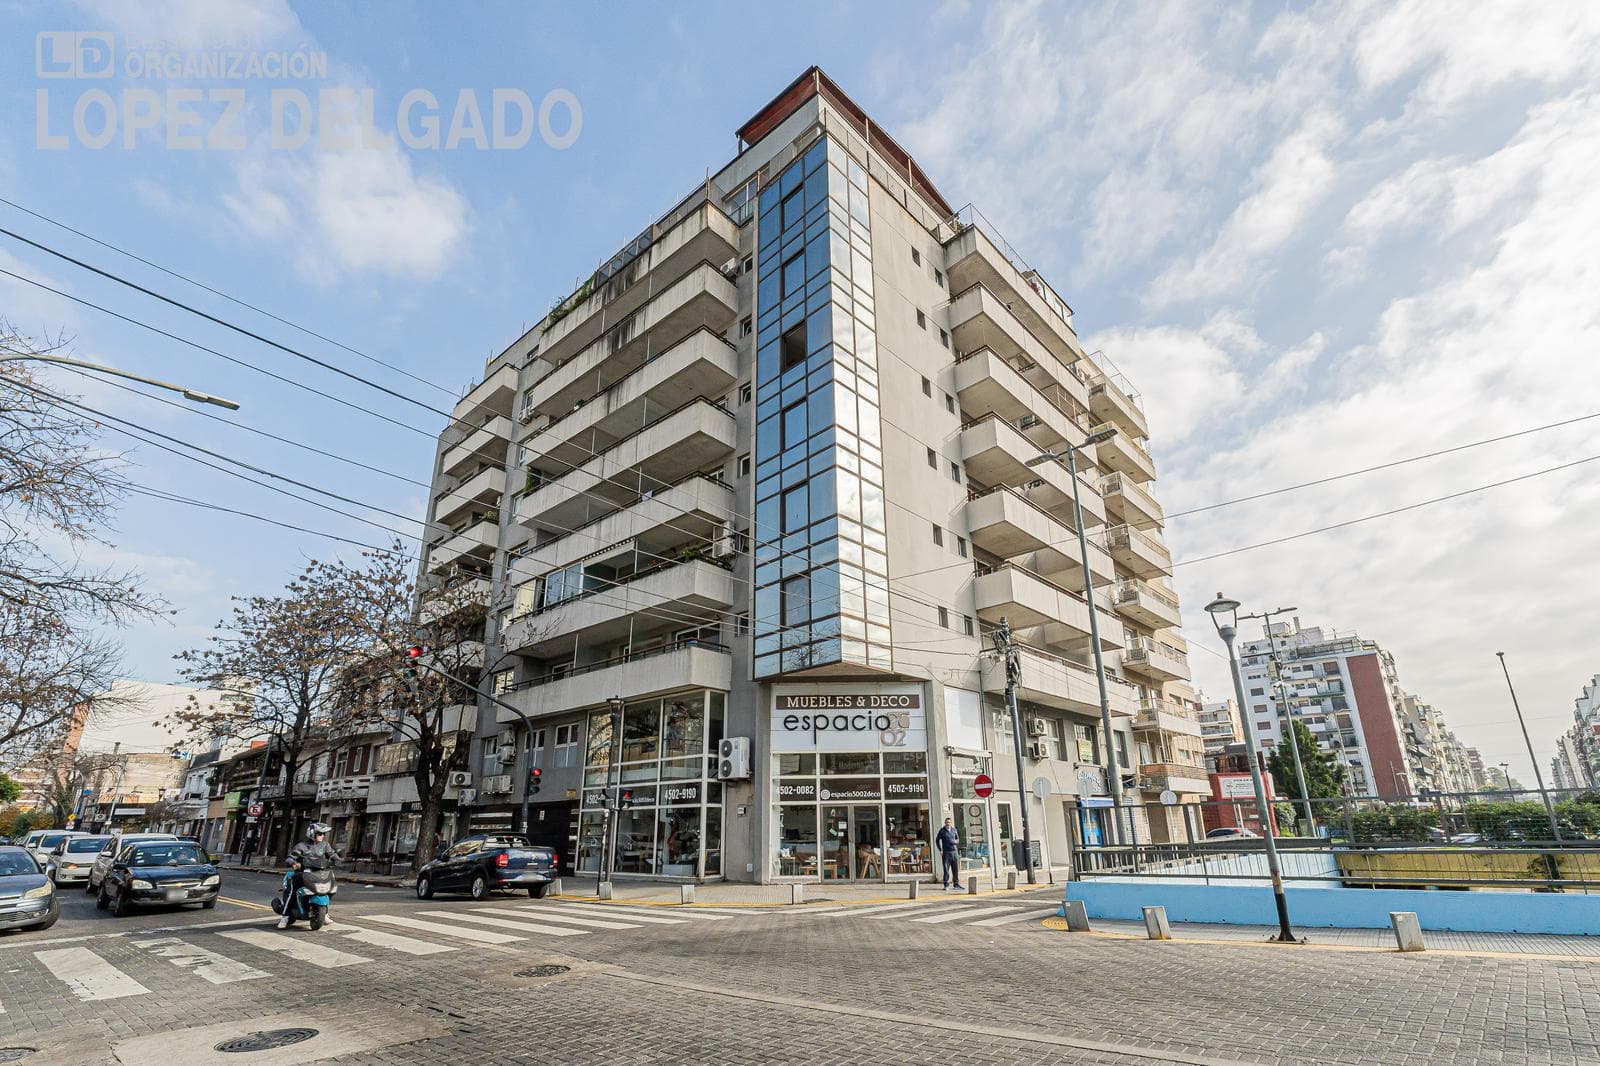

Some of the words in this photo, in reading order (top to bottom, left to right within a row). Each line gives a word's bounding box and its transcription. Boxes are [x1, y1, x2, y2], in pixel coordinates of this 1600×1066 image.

[786, 695, 852, 708] MUEBLES
[856, 695, 866, 707] &
[870, 695, 910, 707] DECO
[783, 710, 891, 745] espacio
[664, 787, 697, 801] 4502-9190
[776, 785, 815, 795] 4502-0082
[887, 784, 925, 794] 4502-9190
